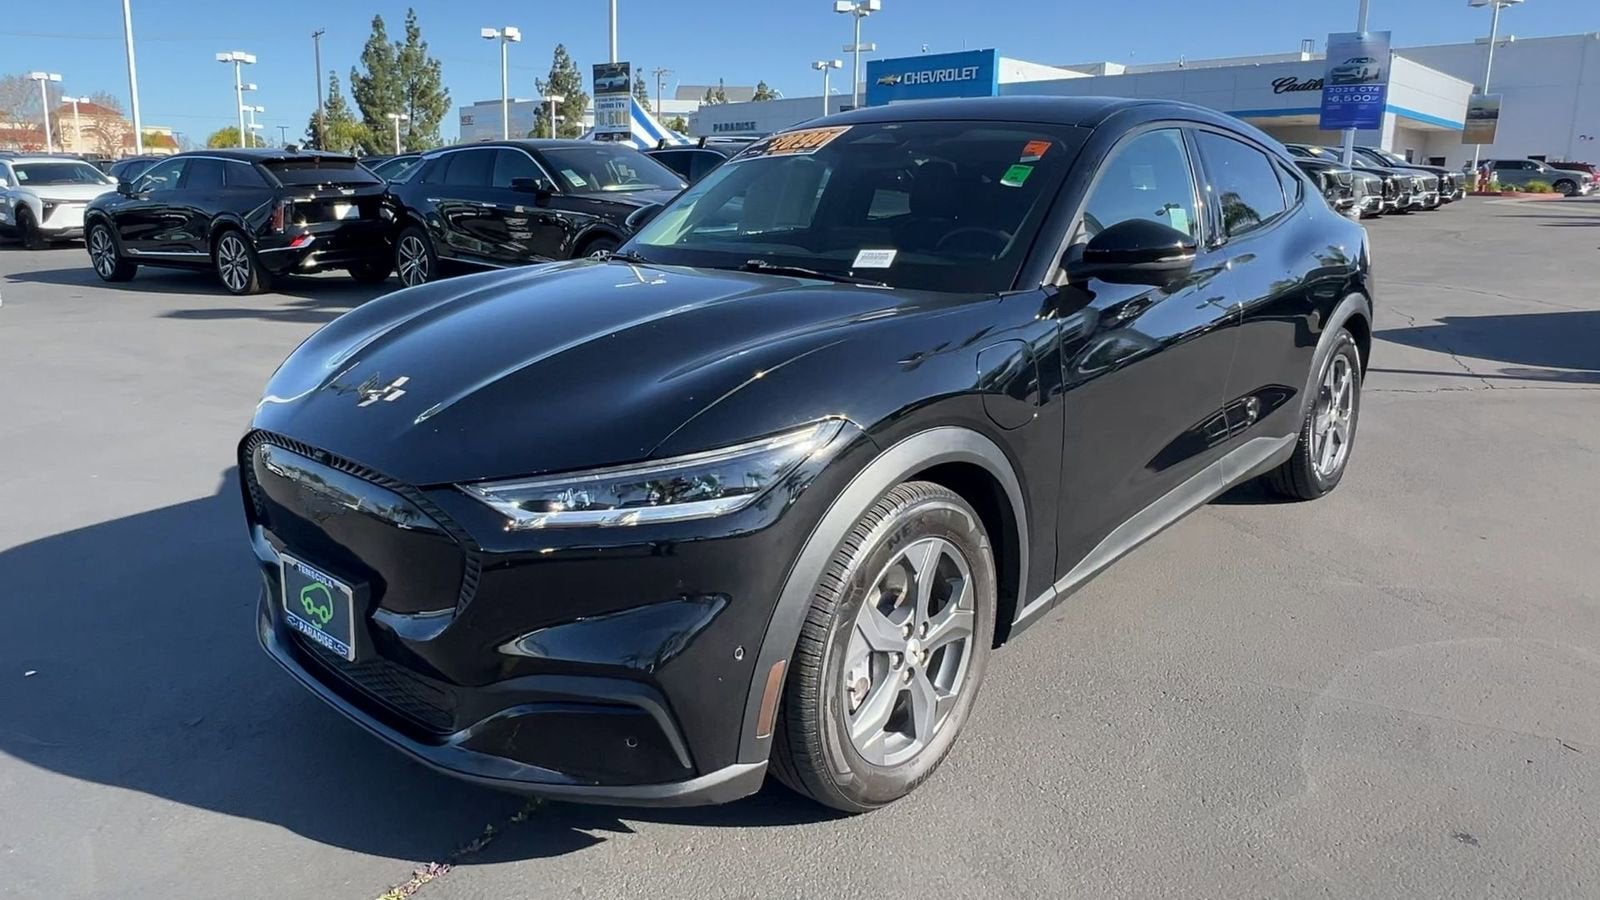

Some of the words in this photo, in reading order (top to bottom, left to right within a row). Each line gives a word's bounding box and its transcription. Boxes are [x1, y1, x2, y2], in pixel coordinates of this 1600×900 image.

[904, 66, 979, 85] CHEVROLET
[713, 121, 756, 133] PARADISE
[297, 563, 334, 589] TEMECULA
[299, 621, 333, 649] PARADISE
